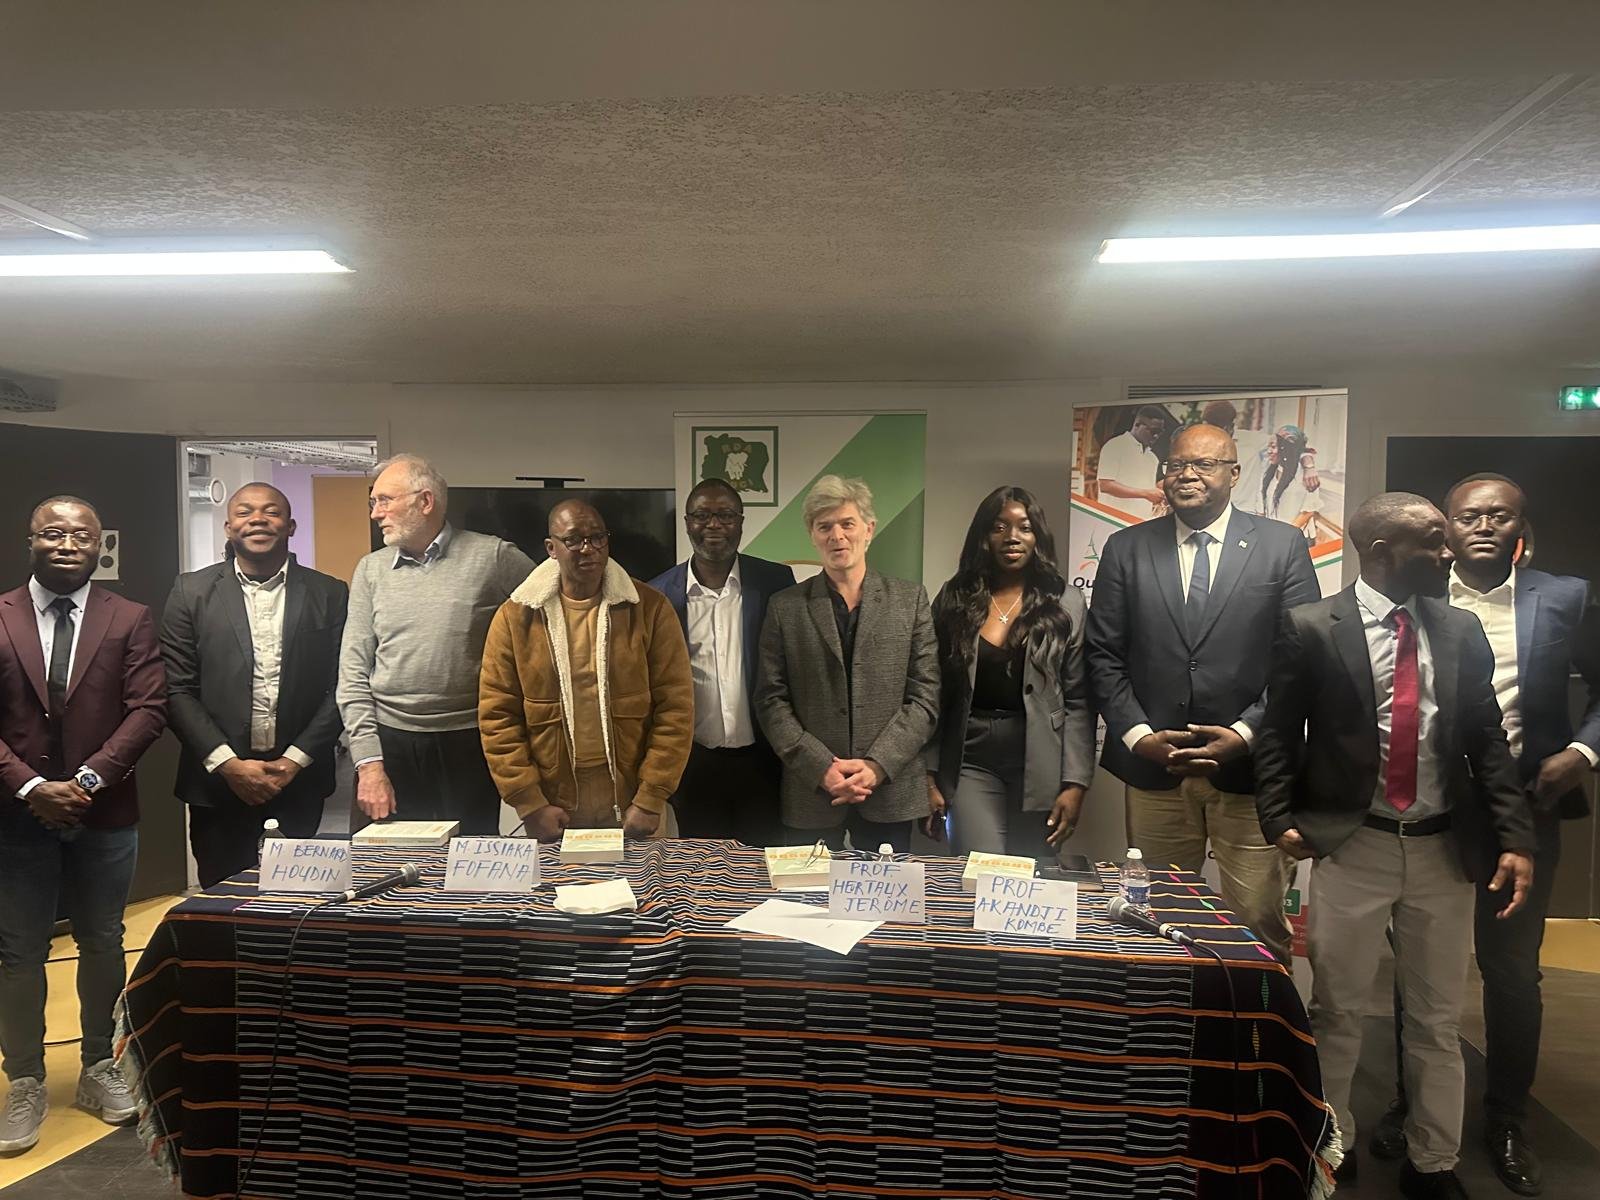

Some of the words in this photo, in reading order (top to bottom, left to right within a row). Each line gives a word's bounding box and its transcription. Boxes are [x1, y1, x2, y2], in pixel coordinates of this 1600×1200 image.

[269, 842, 283, 857] M
[294, 845, 348, 862] BERNARD
[456, 840, 469, 854] M
[474, 840, 534, 860] ISSIAKA
[453, 860, 531, 882] FOFANA
[832, 879, 908, 898] HERTAUX
[991, 876, 1046, 899] PROF
[976, 897, 1068, 921] AKANDJI
[1004, 917, 1061, 934] KOMBE
